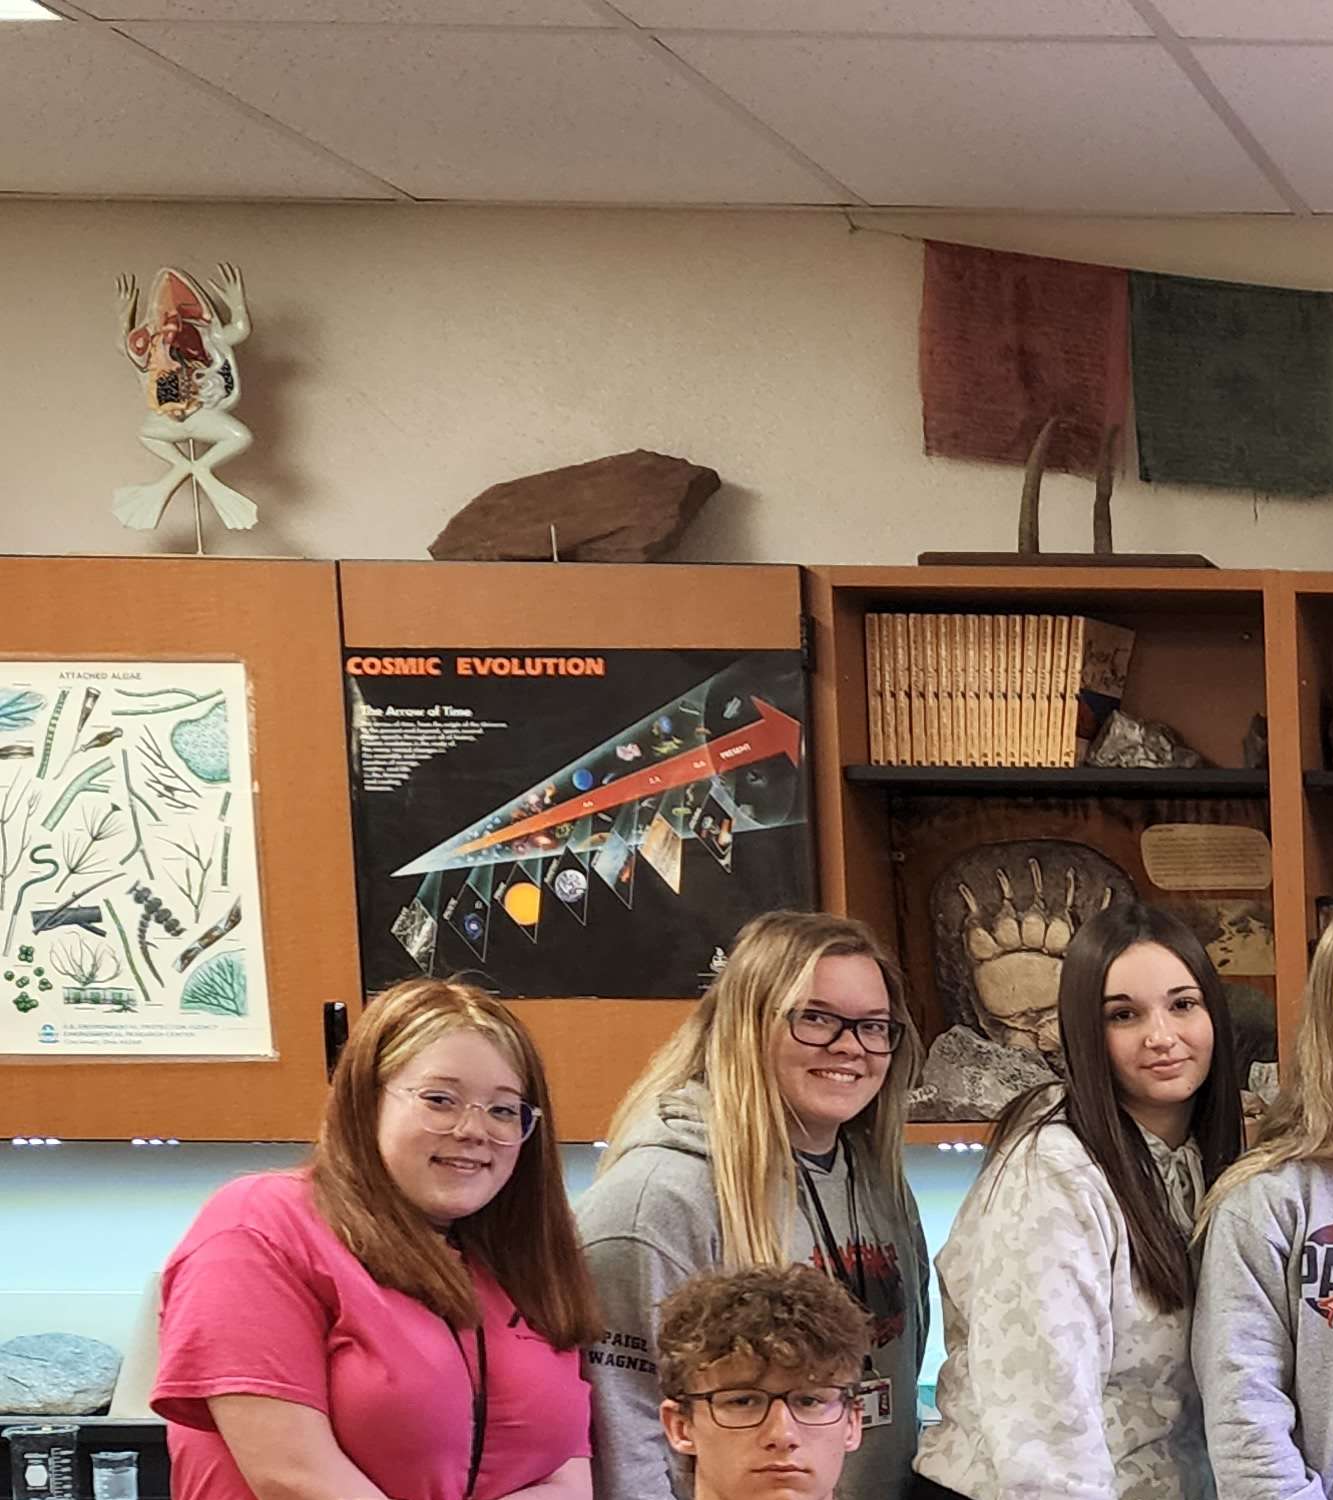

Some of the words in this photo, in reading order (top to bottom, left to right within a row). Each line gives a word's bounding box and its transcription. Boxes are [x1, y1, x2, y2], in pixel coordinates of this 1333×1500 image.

[346, 656, 443, 677] COSMIC
[456, 656, 606, 677] EVOLUTION
[58, 671, 108, 681] ATTACHED
[111, 671, 143, 681] ALGAE
[361, 705, 384, 718] The
[385, 705, 426, 718] Arrow
[426, 704, 441, 718] of
[442, 705, 474, 718] Time
